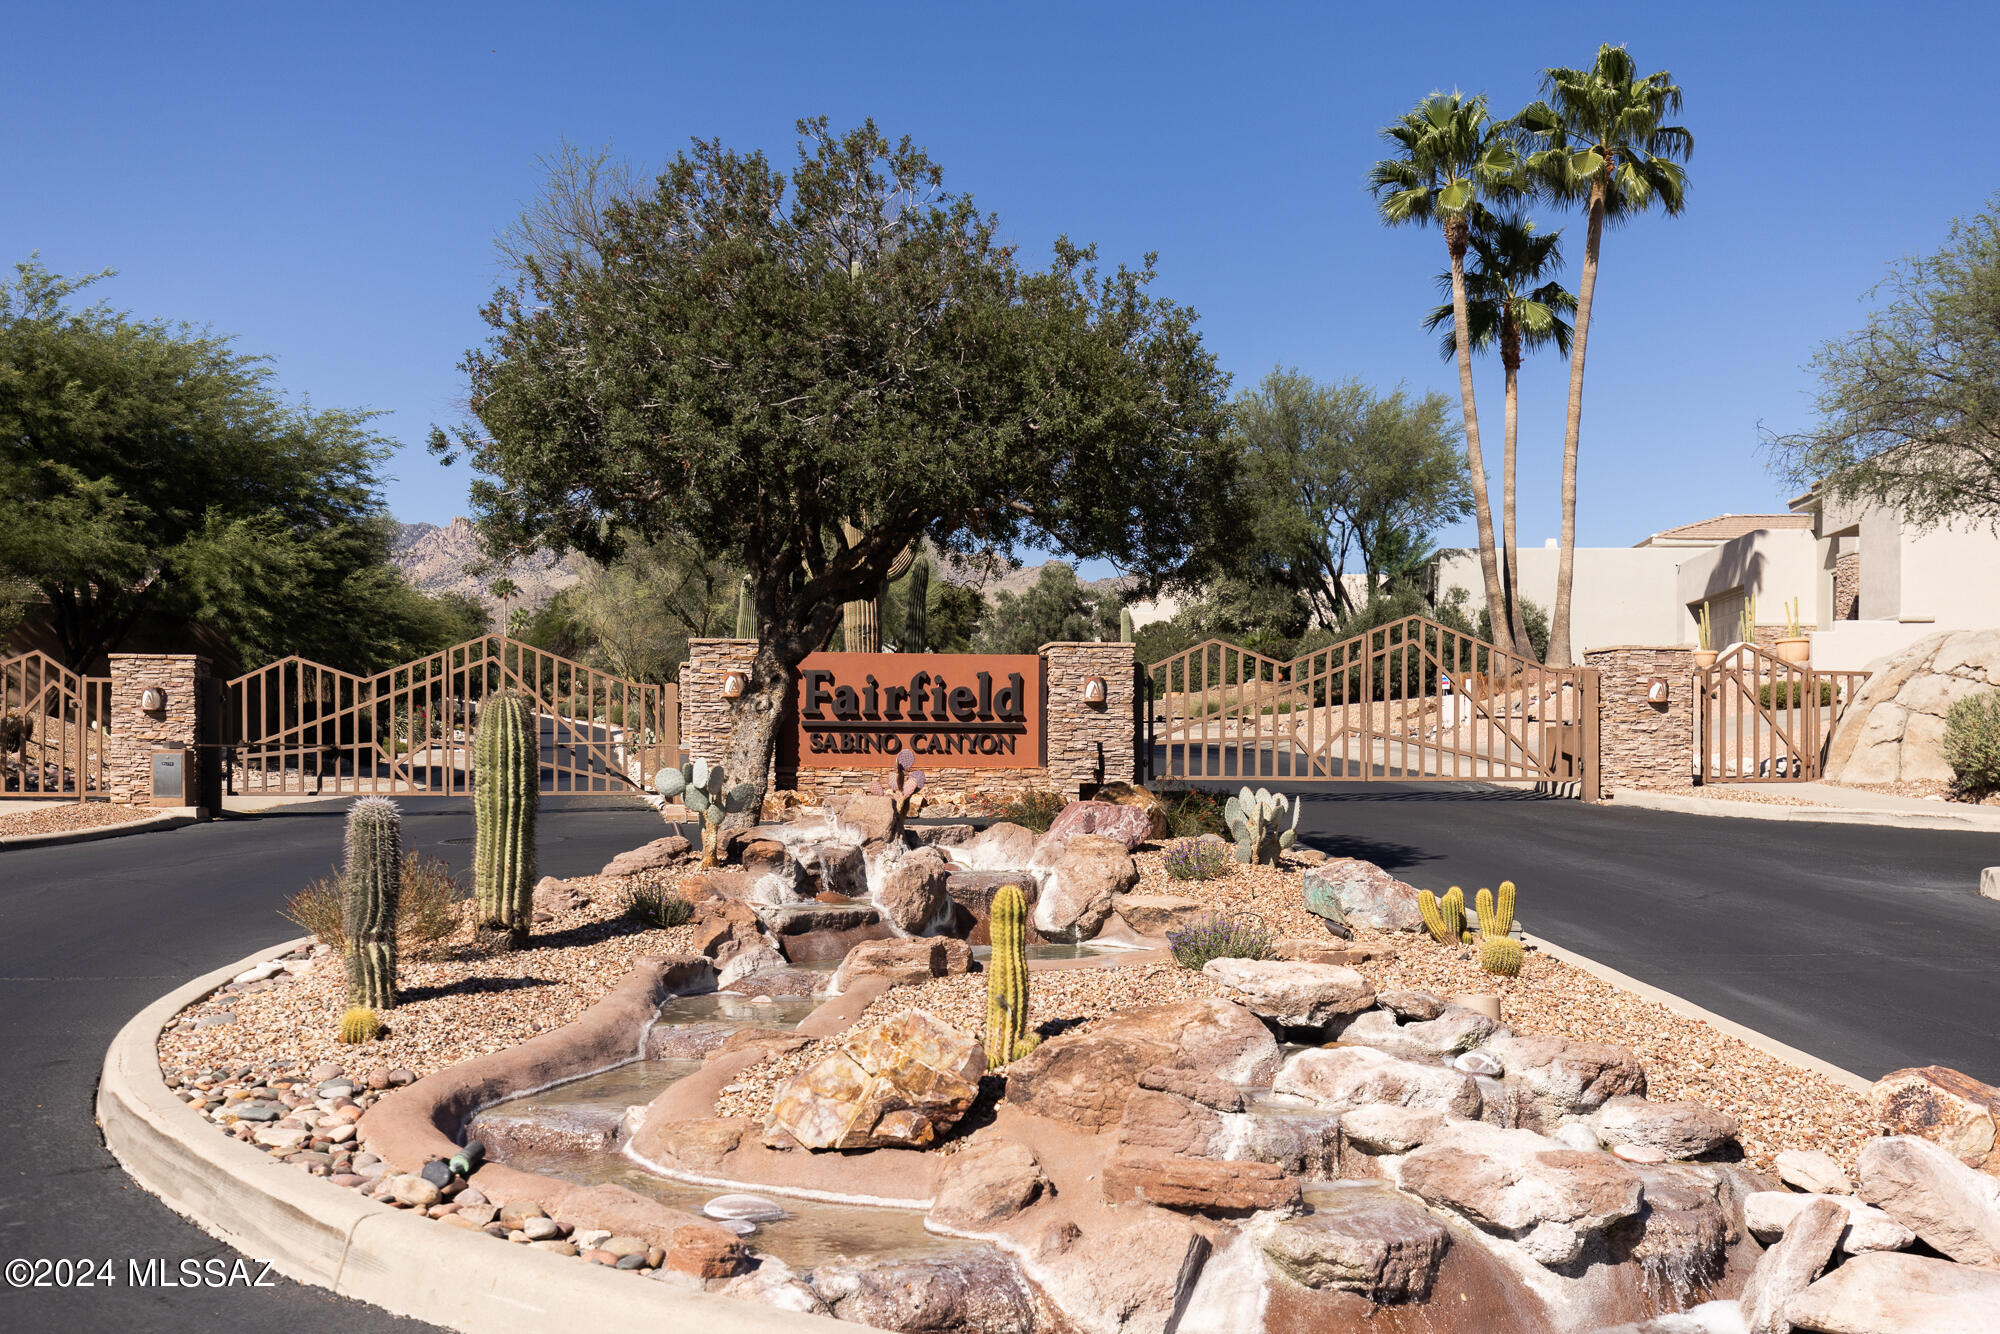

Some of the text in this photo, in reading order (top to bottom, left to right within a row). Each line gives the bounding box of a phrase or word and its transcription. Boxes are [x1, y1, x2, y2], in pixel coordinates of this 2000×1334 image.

[802, 669, 1027, 721] Fairfield
[810, 733, 1016, 755] SABINO CANYON
